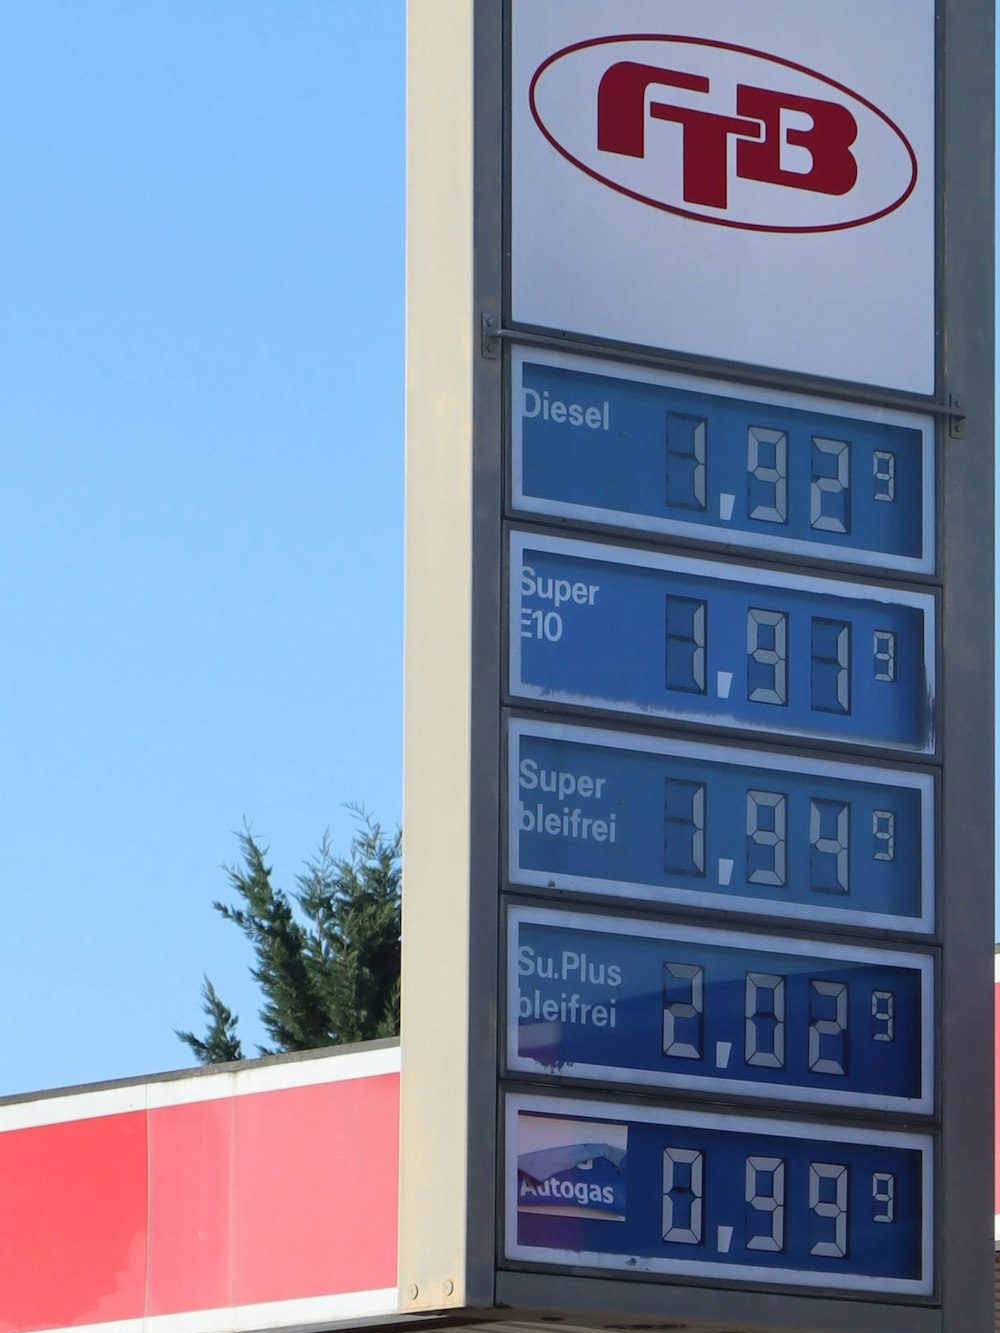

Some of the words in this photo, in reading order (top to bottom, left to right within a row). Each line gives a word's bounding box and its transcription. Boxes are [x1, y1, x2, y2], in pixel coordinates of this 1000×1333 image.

[597, 61, 858, 210] FTB
[521, 387, 609, 430] Diesel
[521, 566, 599, 607] Super
[521, 607, 563, 642] E10
[519, 759, 607, 800] Super
[518, 800, 616, 843] bleifrei
[518, 945, 622, 987] Su.Plus
[518, 987, 616, 1028] bleifrei
[520, 1174, 614, 1205] Autogas
